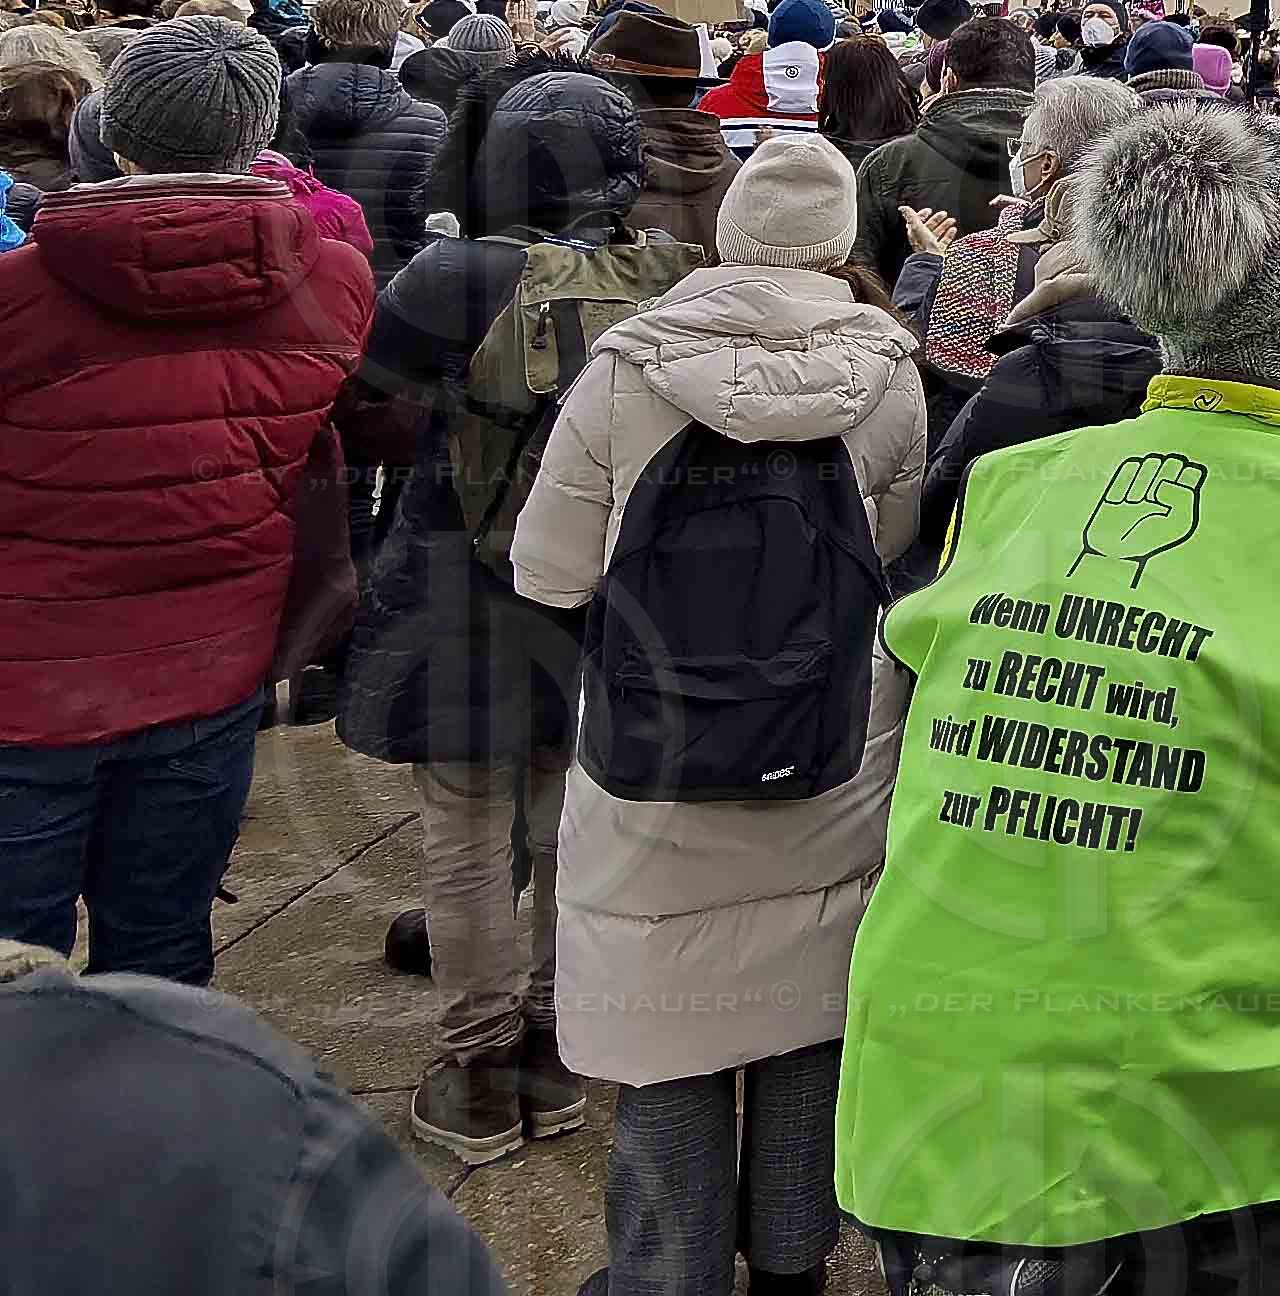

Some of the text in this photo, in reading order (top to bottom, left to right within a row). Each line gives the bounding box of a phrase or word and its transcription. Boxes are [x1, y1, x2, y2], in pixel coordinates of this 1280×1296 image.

[967, 591, 1215, 663] Wenn UNRECHT
[962, 650, 1180, 729] zu RECHT wird,
[929, 714, 1208, 794] wird WIDERSTAND
[937, 784, 1144, 854] zur PFLICHT!
